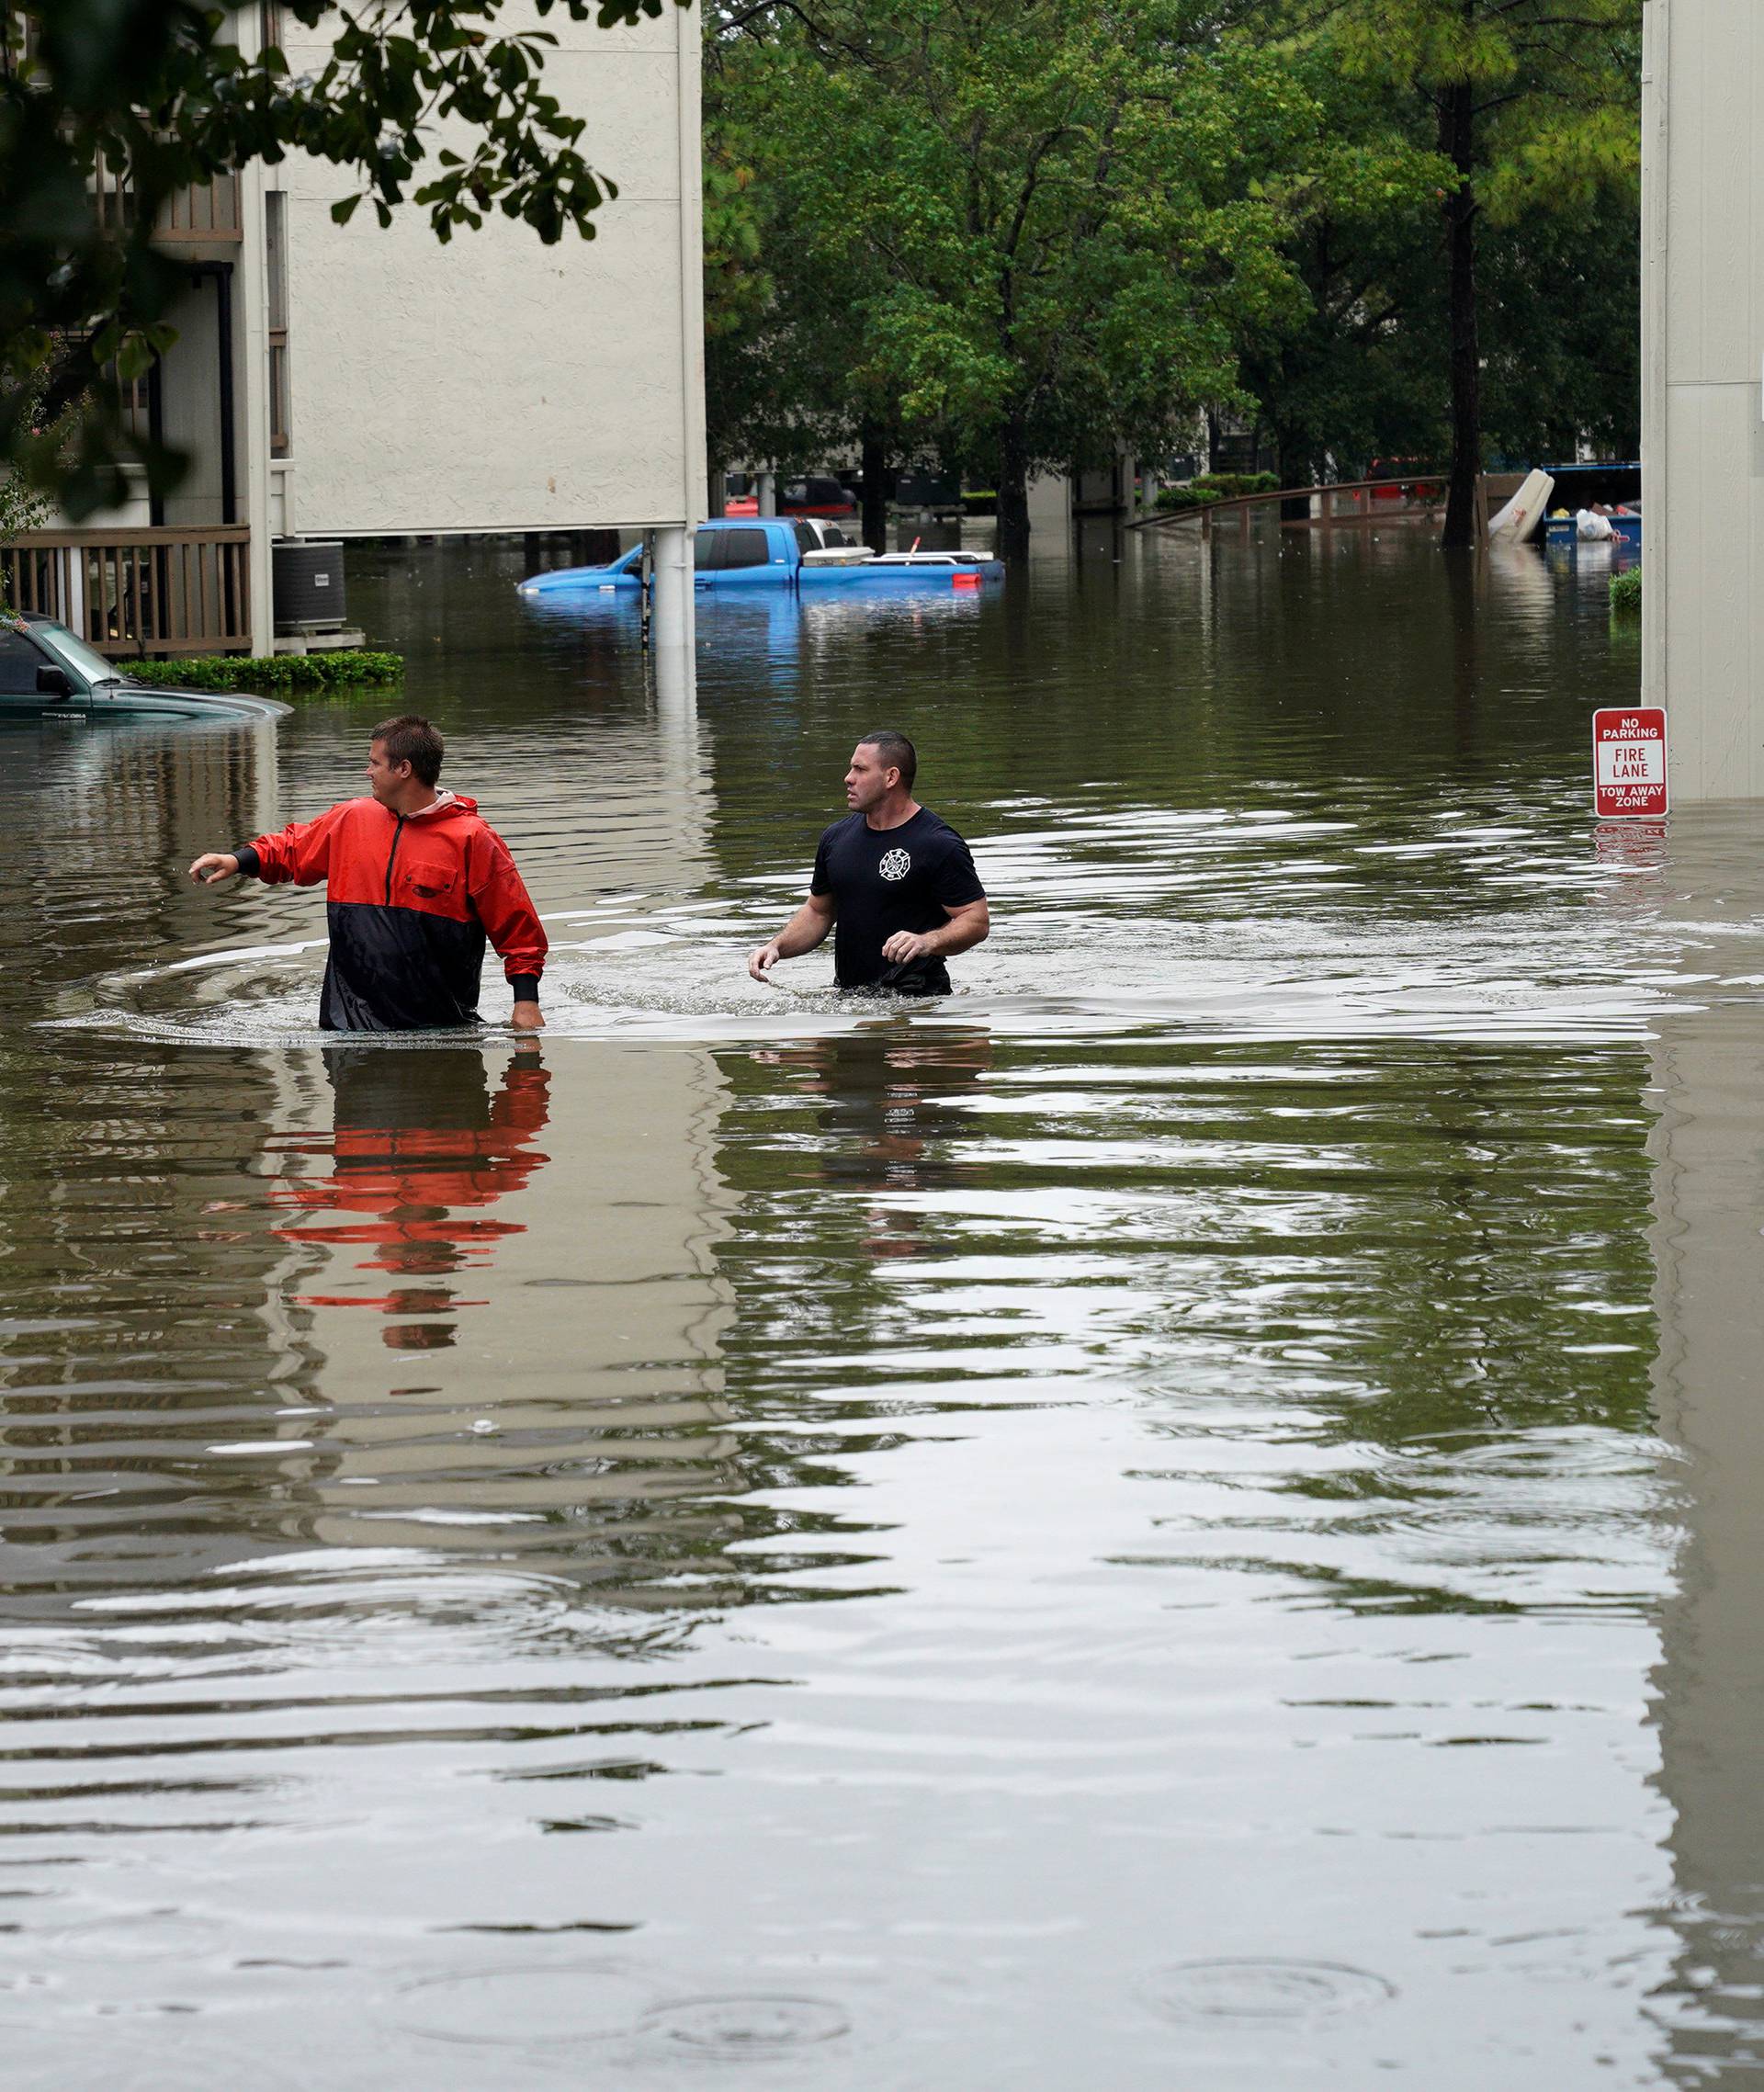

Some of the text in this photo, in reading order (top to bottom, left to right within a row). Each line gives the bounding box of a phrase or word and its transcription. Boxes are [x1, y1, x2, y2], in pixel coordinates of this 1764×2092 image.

[1622, 718, 1639, 729] NO
[1602, 728, 1658, 740] PARKING
[1615, 748, 1645, 762] FIRE
[1612, 763, 1649, 777] LANE
[1600, 786, 1664, 797] TOW AWAY
[1615, 797, 1648, 807] ZONE
